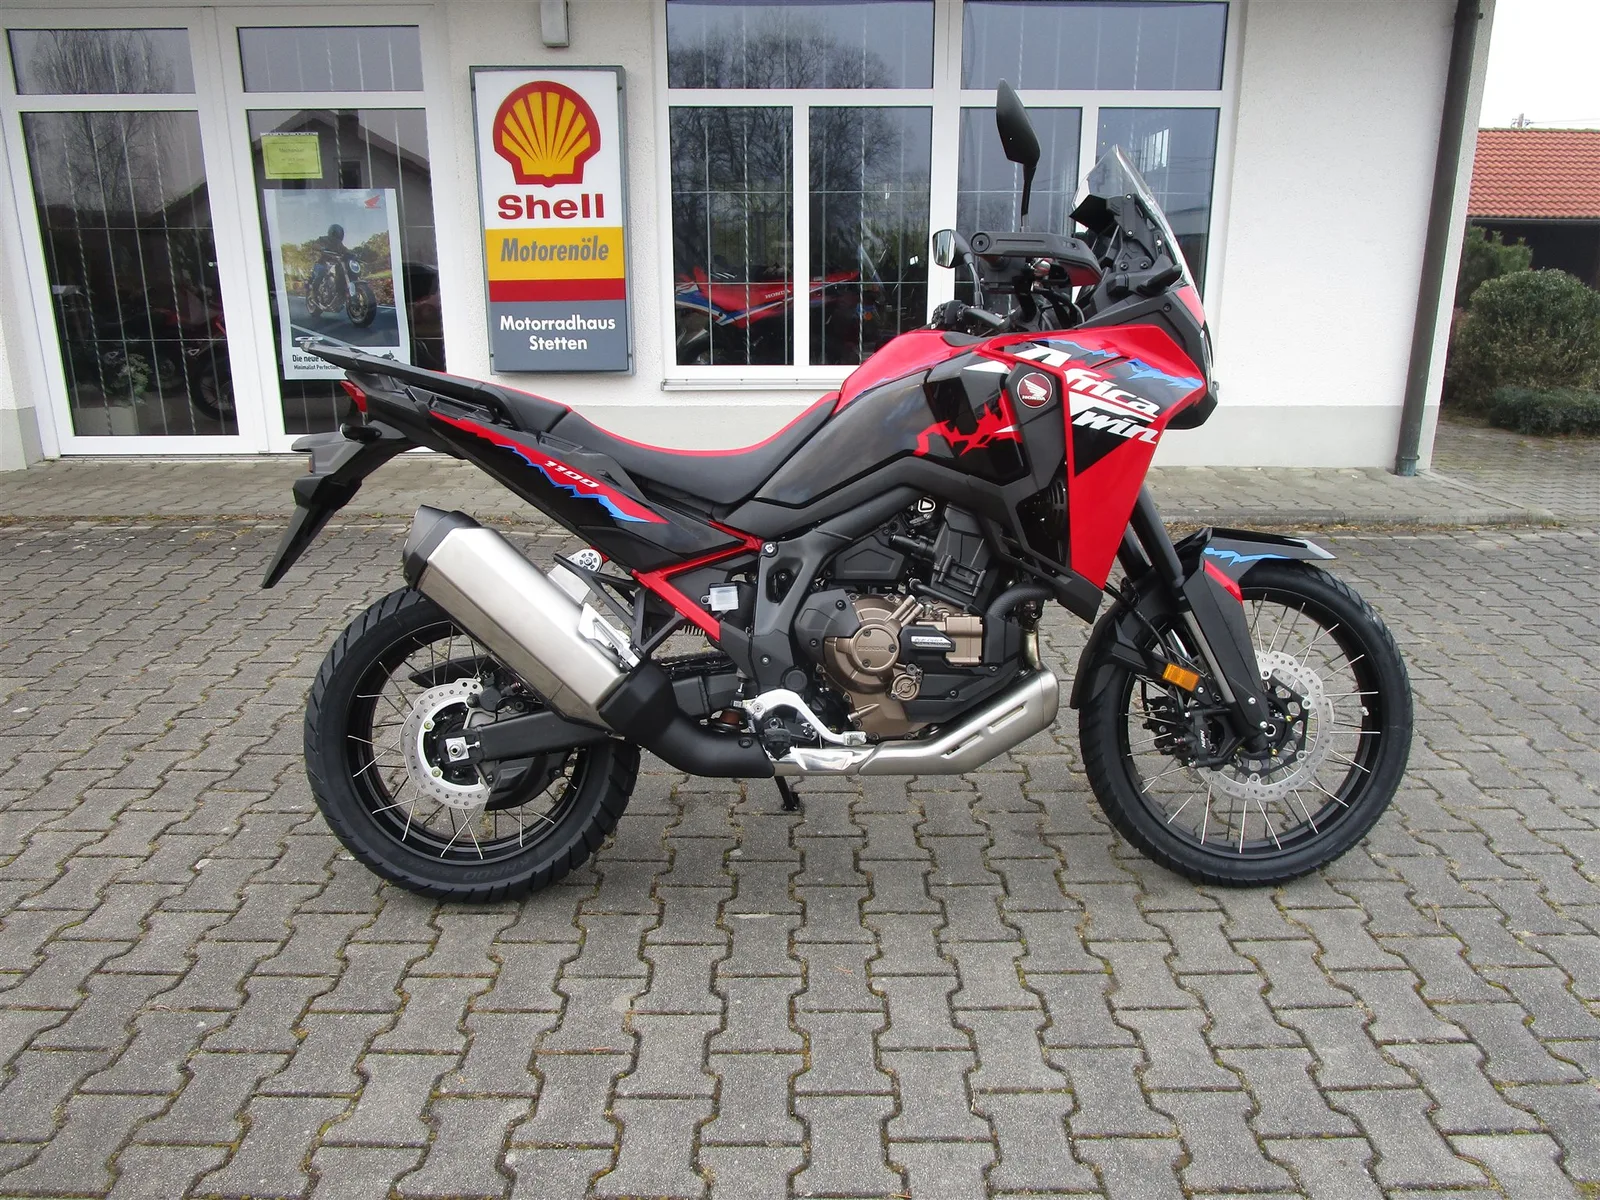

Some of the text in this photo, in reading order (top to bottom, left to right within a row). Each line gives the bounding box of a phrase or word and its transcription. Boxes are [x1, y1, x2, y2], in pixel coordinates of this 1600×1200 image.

[497, 193, 605, 219] Shell
[500, 236, 608, 262] Motorenöle
[500, 314, 616, 331] Motorradhaus
[529, 335, 588, 351] Stetten
[292, 354, 303, 362] Die
[545, 460, 600, 488] 1100
